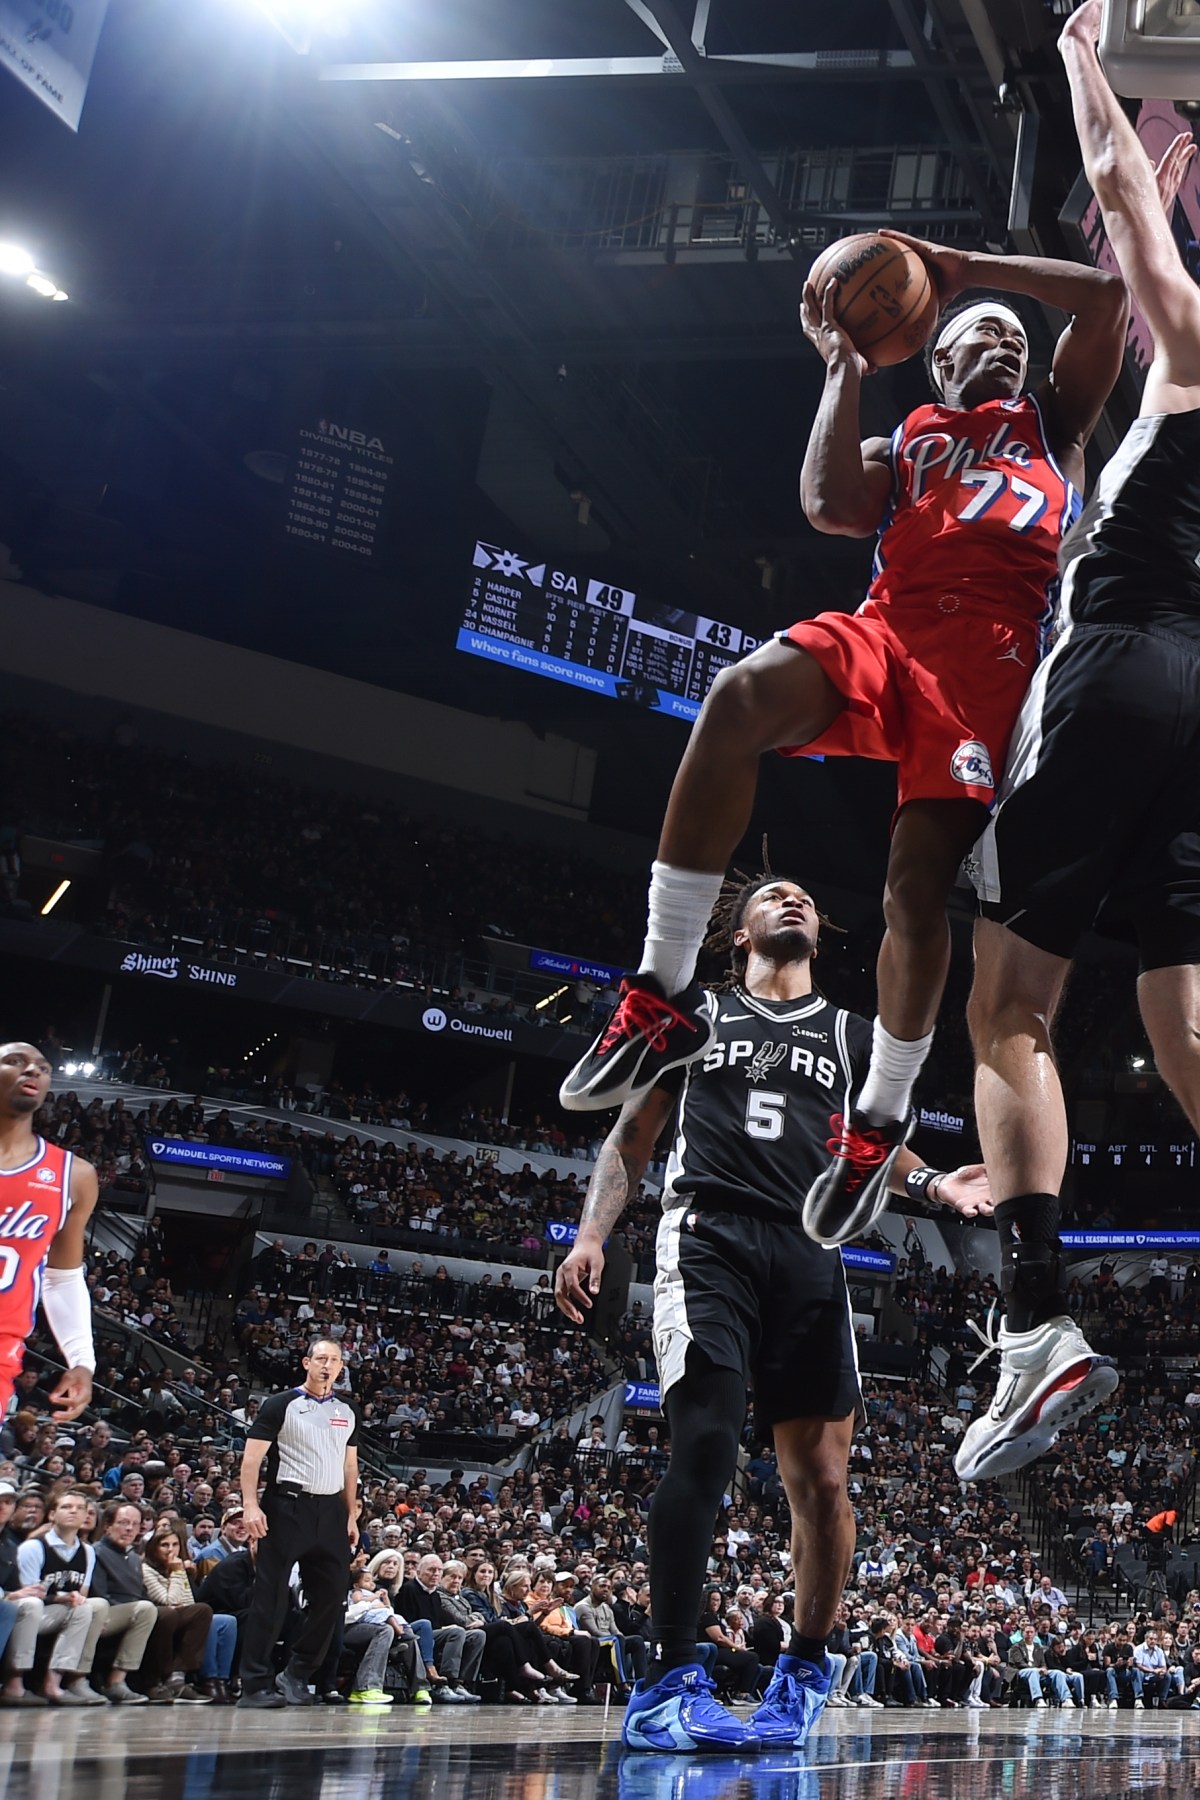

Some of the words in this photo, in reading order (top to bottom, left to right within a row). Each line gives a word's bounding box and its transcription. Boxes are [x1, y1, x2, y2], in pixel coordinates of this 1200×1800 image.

[328, 423, 385, 452] NBA
[904, 423, 1031, 506] Phila
[957, 469, 1047, 532] 77
[487, 581, 522, 599] HARPER
[551, 571, 578, 595] SA
[485, 592, 518, 610] CASTLE
[596, 585, 624, 611] 49
[481, 613, 517, 633] VASSELL
[483, 603, 518, 621] KORNET
[478, 624, 535, 649] CHAMPAGNIE
[706, 622, 732, 648] 43
[471, 637, 510, 658] Where
[511, 650, 539, 668] fans
[540, 661, 574, 678] score
[575, 671, 605, 687] more
[120, 952, 180, 978] Shiner
[579, 967, 611, 980] ULTRA
[450, 1019, 513, 1041] Ownwell
[744, 1089, 788, 1142] 5
[920, 1108, 964, 1126] beldon
[166, 1147, 208, 1160] FANDUEL
[209, 1153, 241, 1165] SPORTS
[243, 1158, 284, 1171] NETWORK
[478, 1149, 498, 1161] 126
[1077, 1144, 1096, 1152] REB
[1108, 1144, 1127, 1152] AST
[1140, 1144, 1158, 1152] STL
[1170, 1144, 1188, 1152] BLK
[0, 1201, 49, 1240] ila
[862, 1256, 891, 1266] NETWORK
